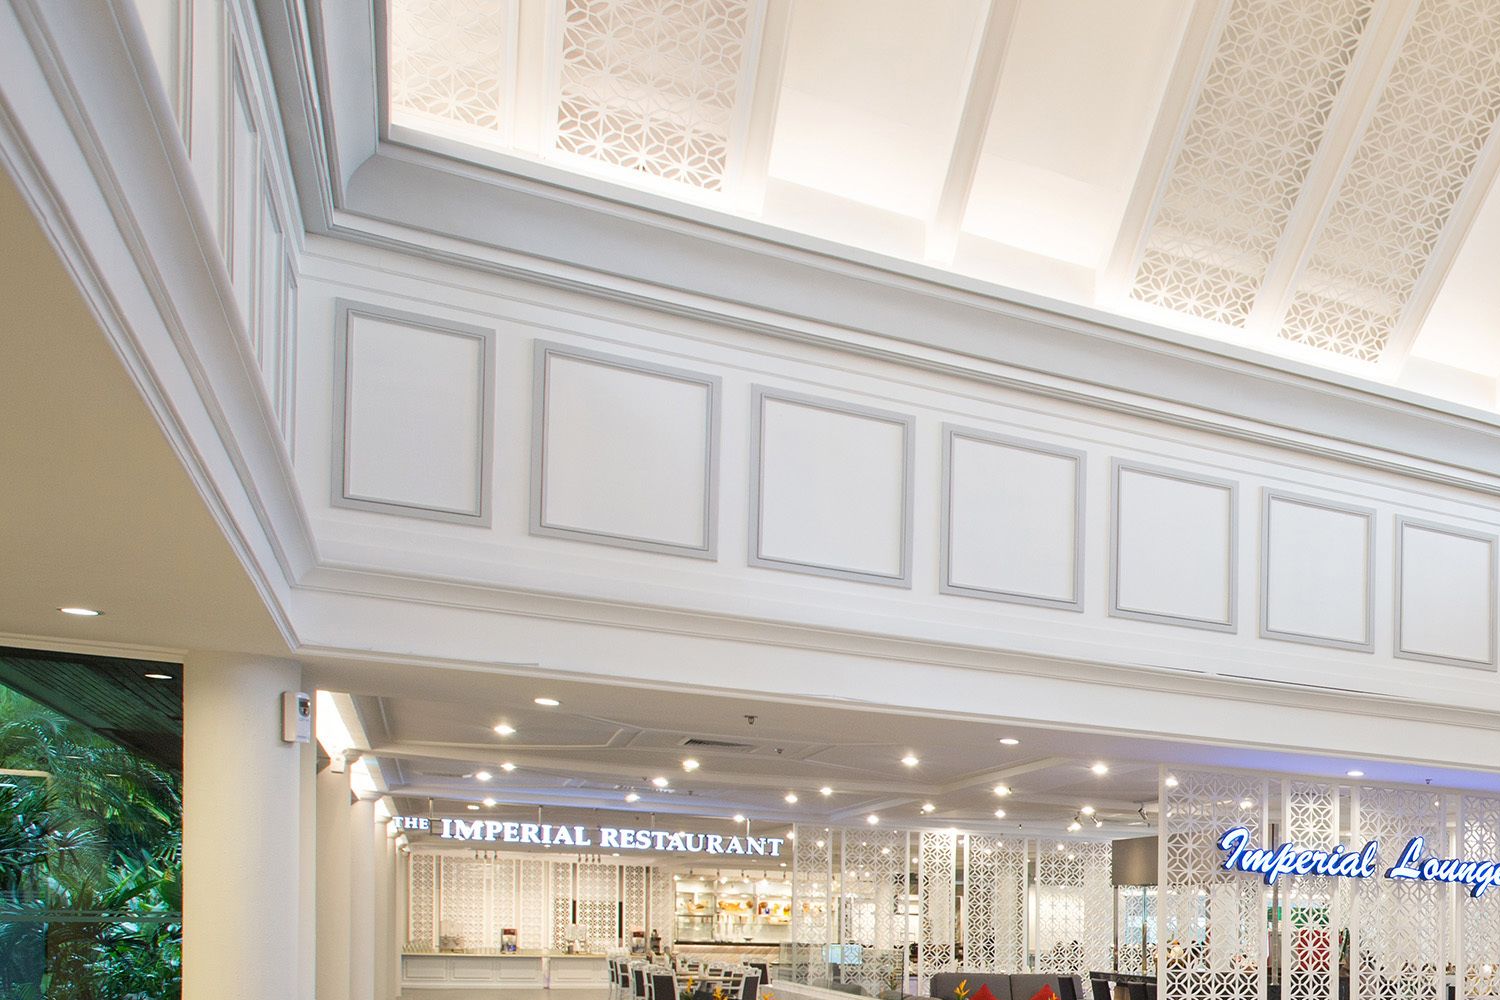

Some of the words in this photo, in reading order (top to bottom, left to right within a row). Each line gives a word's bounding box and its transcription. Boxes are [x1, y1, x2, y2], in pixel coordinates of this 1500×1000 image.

[392, 816, 430, 830] THE
[441, 818, 591, 846] IMPERIAL
[600, 828, 784, 857] RESTAURANT
[1217, 826, 1378, 885] Imperial
